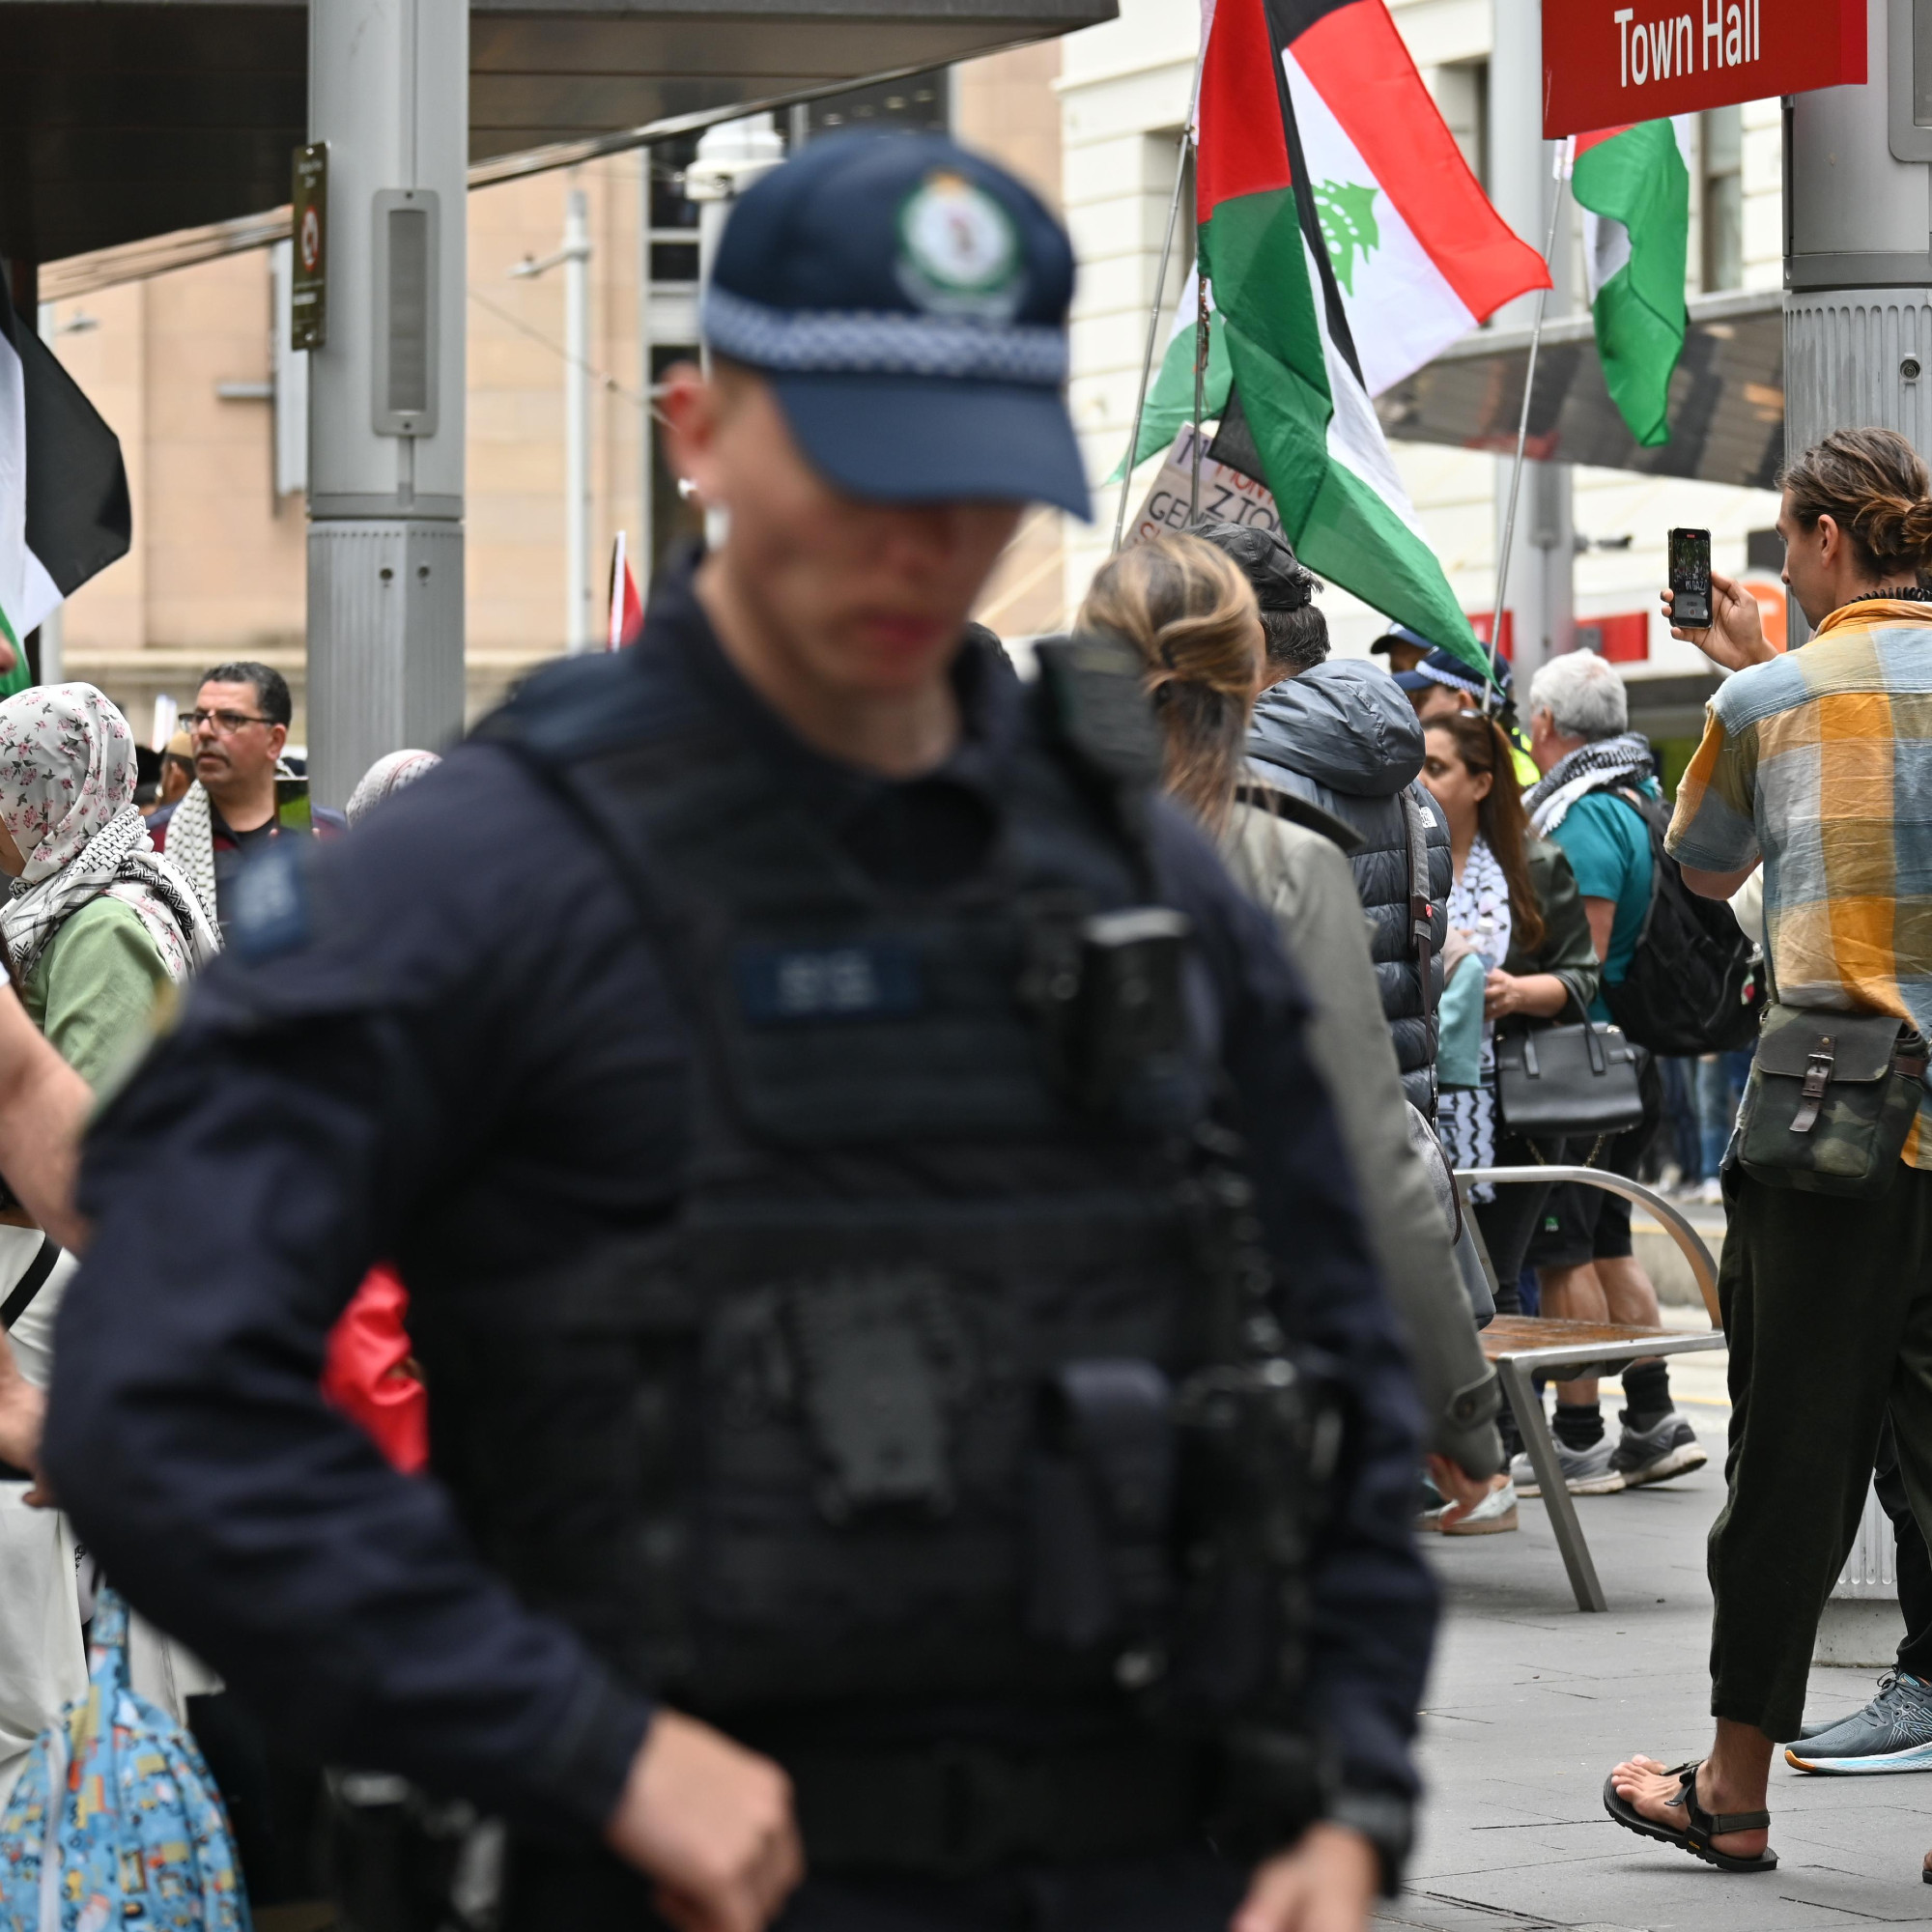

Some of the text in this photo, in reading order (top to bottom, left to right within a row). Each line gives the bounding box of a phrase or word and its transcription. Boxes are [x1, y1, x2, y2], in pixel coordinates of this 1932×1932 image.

[1614, 0, 1760, 88] Town Hall
[1206, 484, 1281, 532] ZIO
